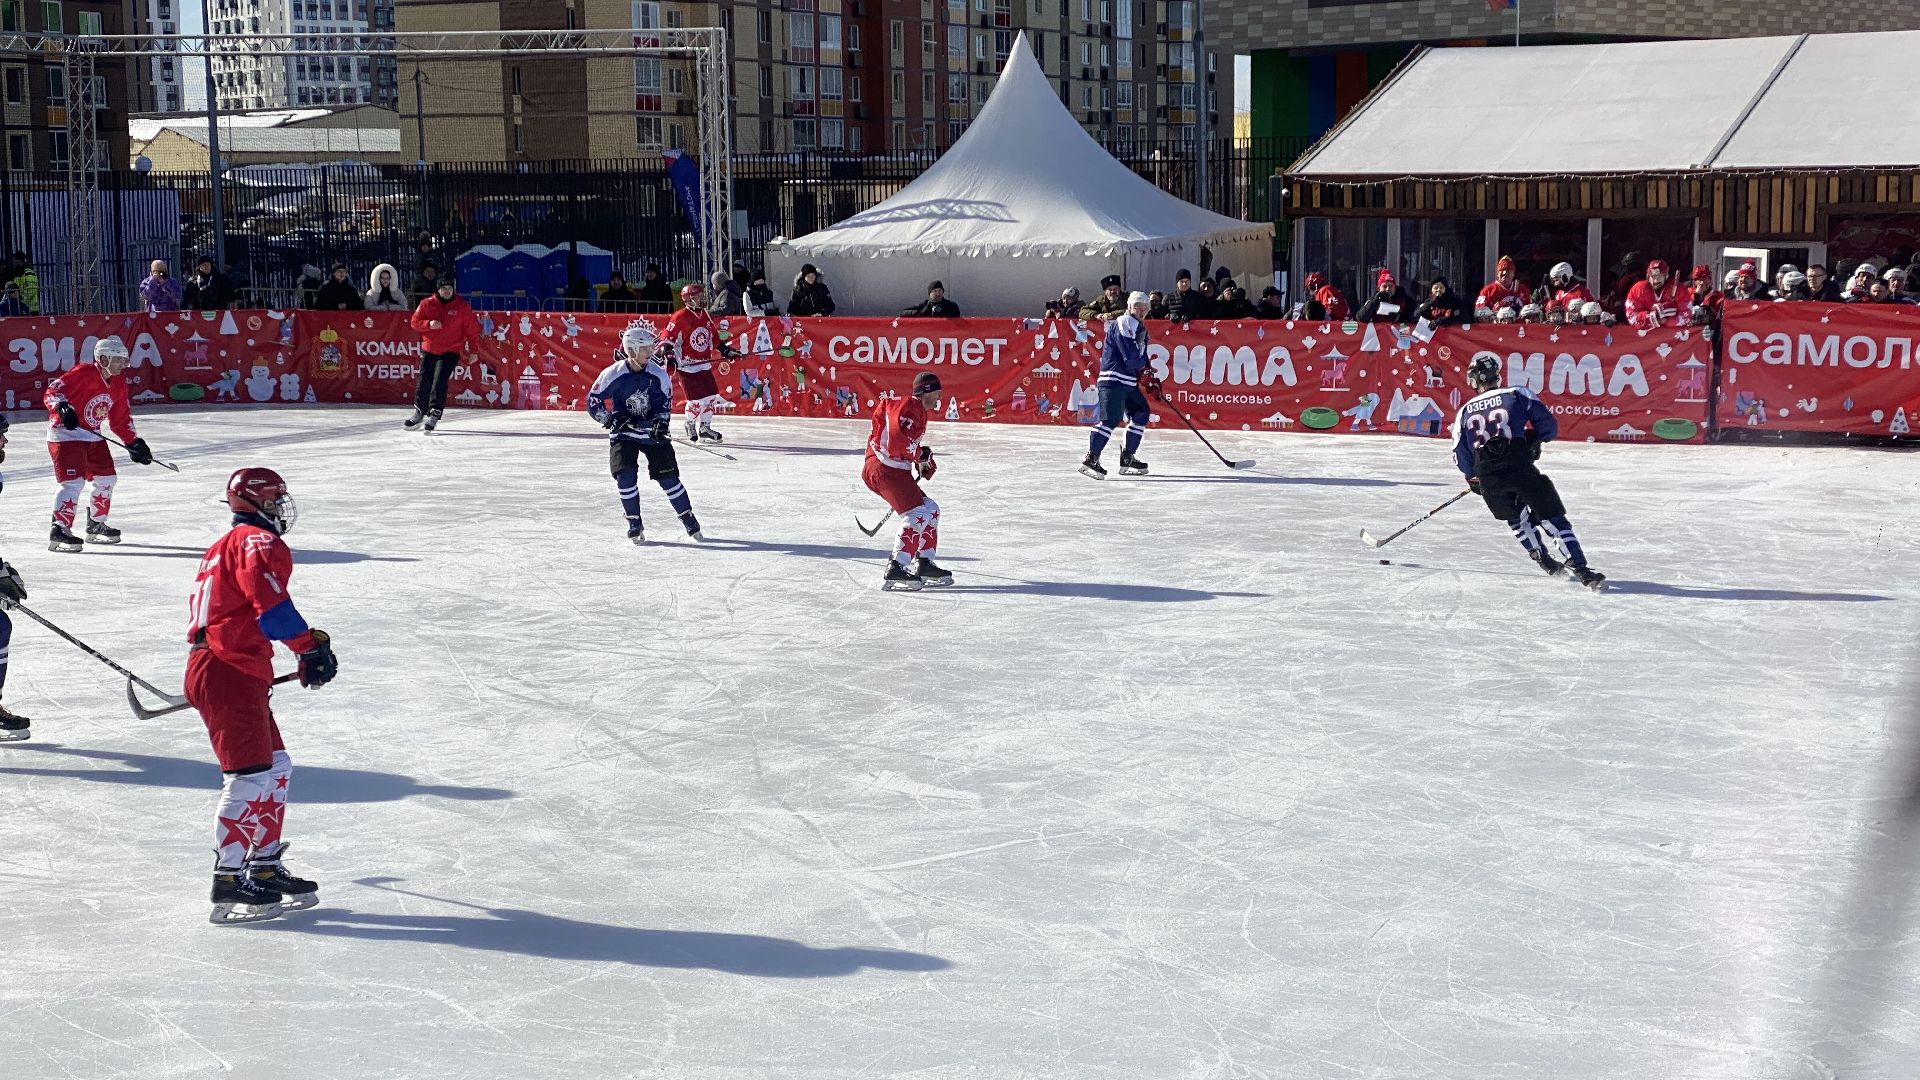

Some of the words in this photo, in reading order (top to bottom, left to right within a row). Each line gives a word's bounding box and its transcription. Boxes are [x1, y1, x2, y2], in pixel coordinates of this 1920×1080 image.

[9, 332, 163, 373] ЗИА
[356, 341, 420, 356] КОМАН
[828, 335, 1007, 366] самолет
[1728, 331, 1920, 369] самол
[357, 364, 473, 380] ГУБЕРНРА
[1146, 344, 1298, 386] ЗИМА
[1165, 393, 1172, 402] в
[1177, 390, 1272, 405] Подмосковье
[1466, 395, 1503, 414] ОЗЕРОВ
[1545, 404, 1620, 416] московье
[1466, 408, 1513, 448] 33
